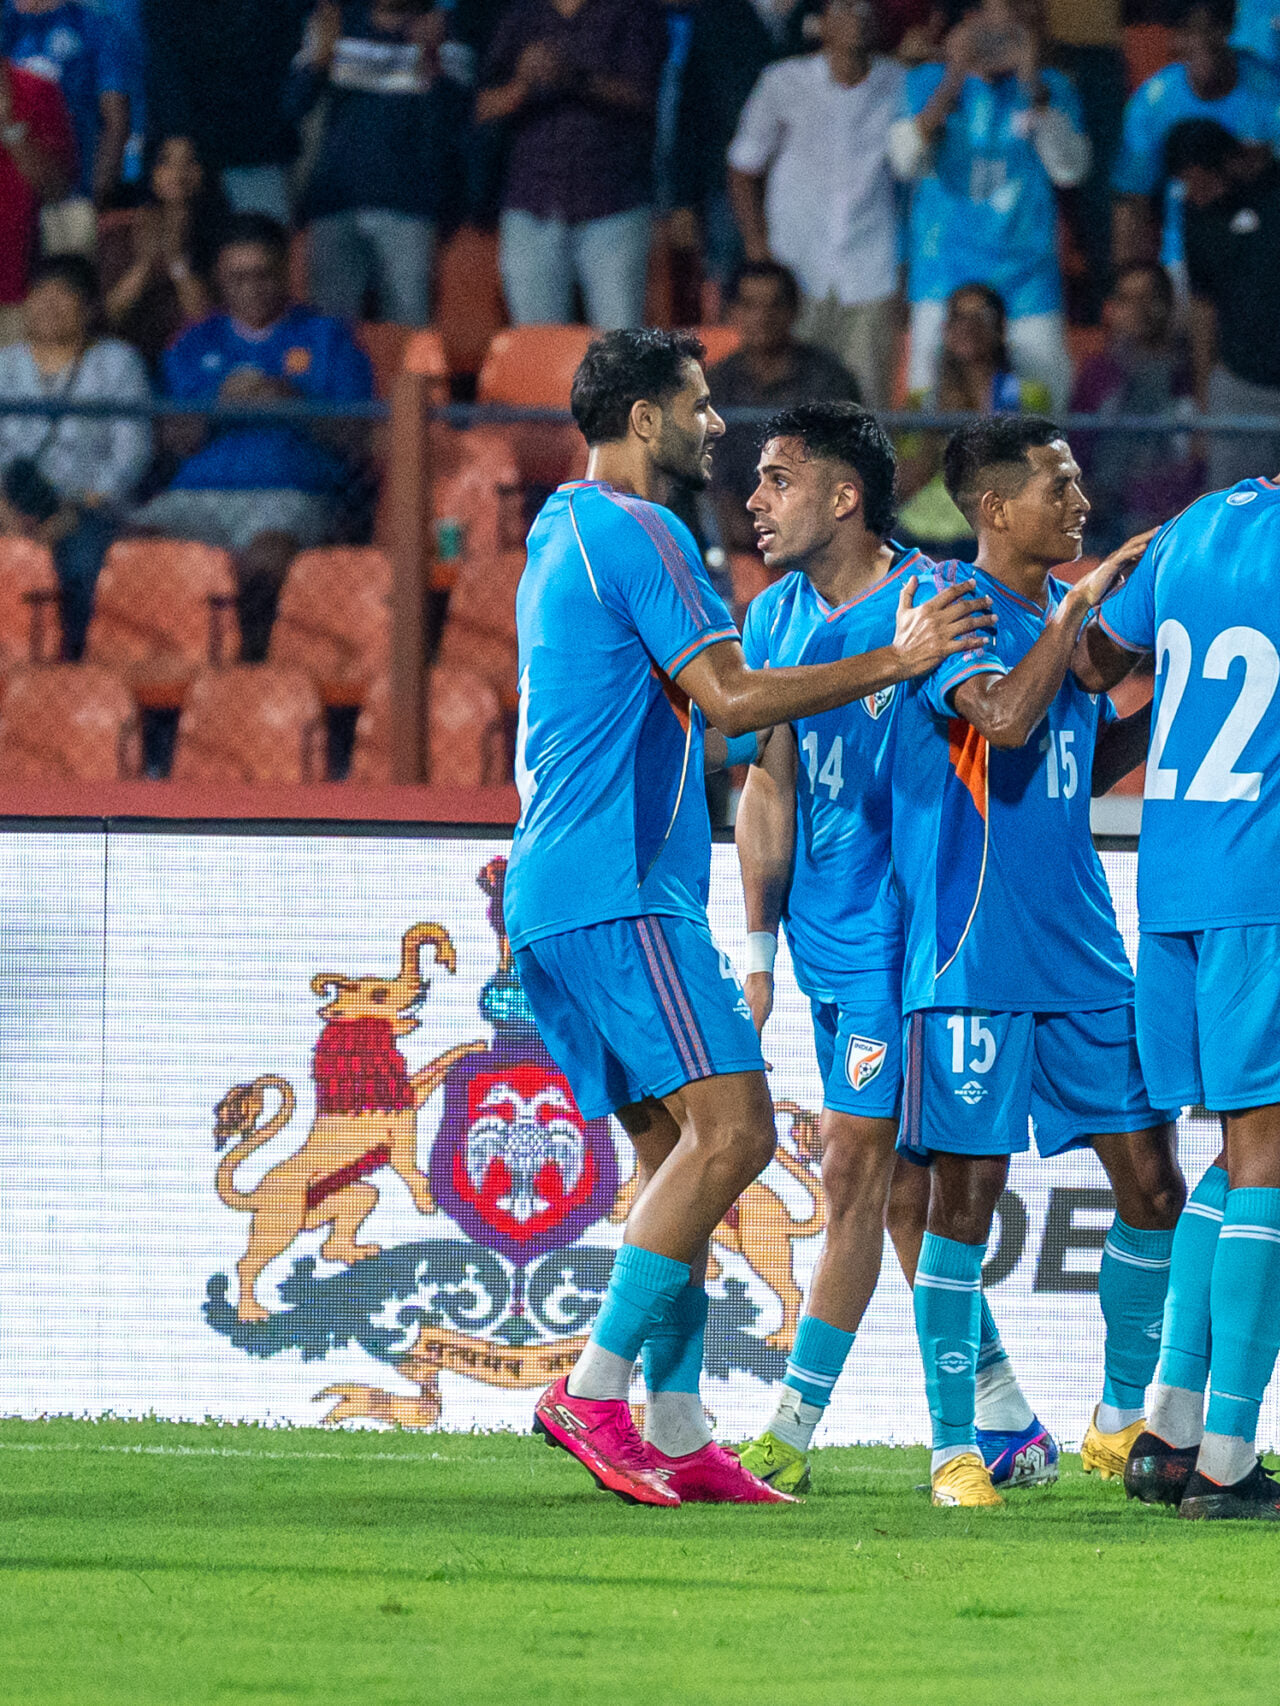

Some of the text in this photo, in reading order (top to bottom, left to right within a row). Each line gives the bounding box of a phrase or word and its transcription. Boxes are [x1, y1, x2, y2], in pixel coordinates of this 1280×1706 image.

[1144, 618, 1280, 803] 22
[802, 731, 844, 800] 14
[1039, 730, 1078, 799] 15
[947, 1009, 997, 1074] 15
